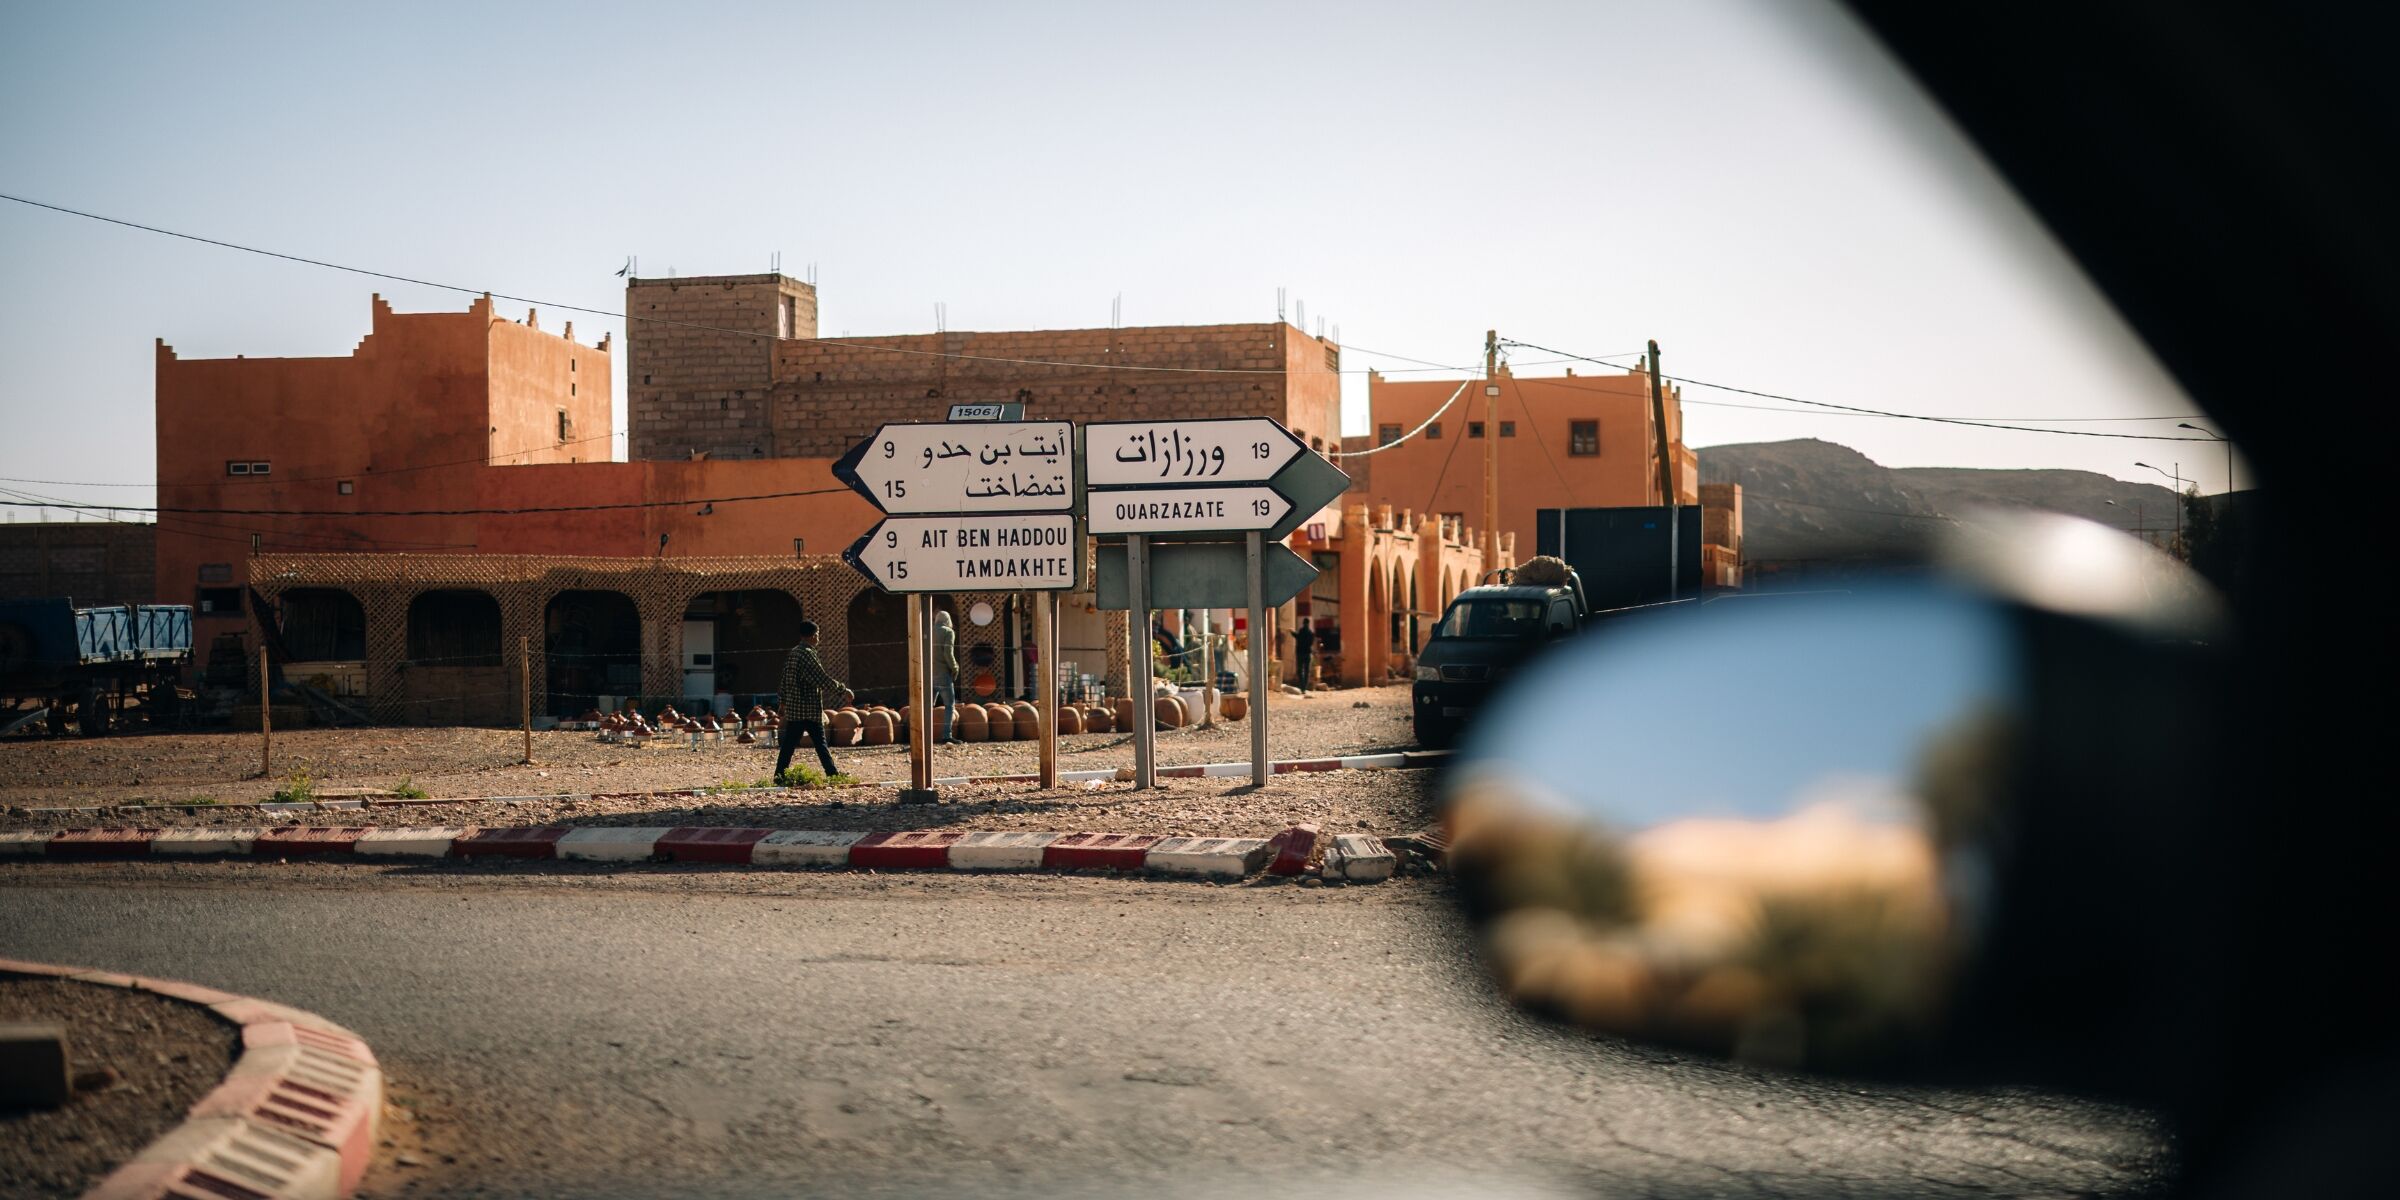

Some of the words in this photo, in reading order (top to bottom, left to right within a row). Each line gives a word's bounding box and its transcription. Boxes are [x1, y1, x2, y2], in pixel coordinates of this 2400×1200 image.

[883, 440, 896, 460] 9
[922, 440, 972, 470] حدو
[979, 443, 1012, 466] بن
[1018, 428, 1066, 466] أيت
[1115, 428, 1225, 477] ورزازات
[1251, 442, 1270, 460] 19
[884, 479, 906, 499] 15
[965, 472, 1066, 499] تمضاخت
[1115, 500, 1225, 521] OUARZAZATE
[1251, 499, 1270, 517] 19
[885, 530, 898, 549] 9
[921, 529, 948, 549] AIT
[956, 528, 990, 548] BEN
[997, 527, 1067, 547] HADDOU
[886, 560, 908, 580] 15
[955, 557, 1068, 579] TAMDAKHTE
